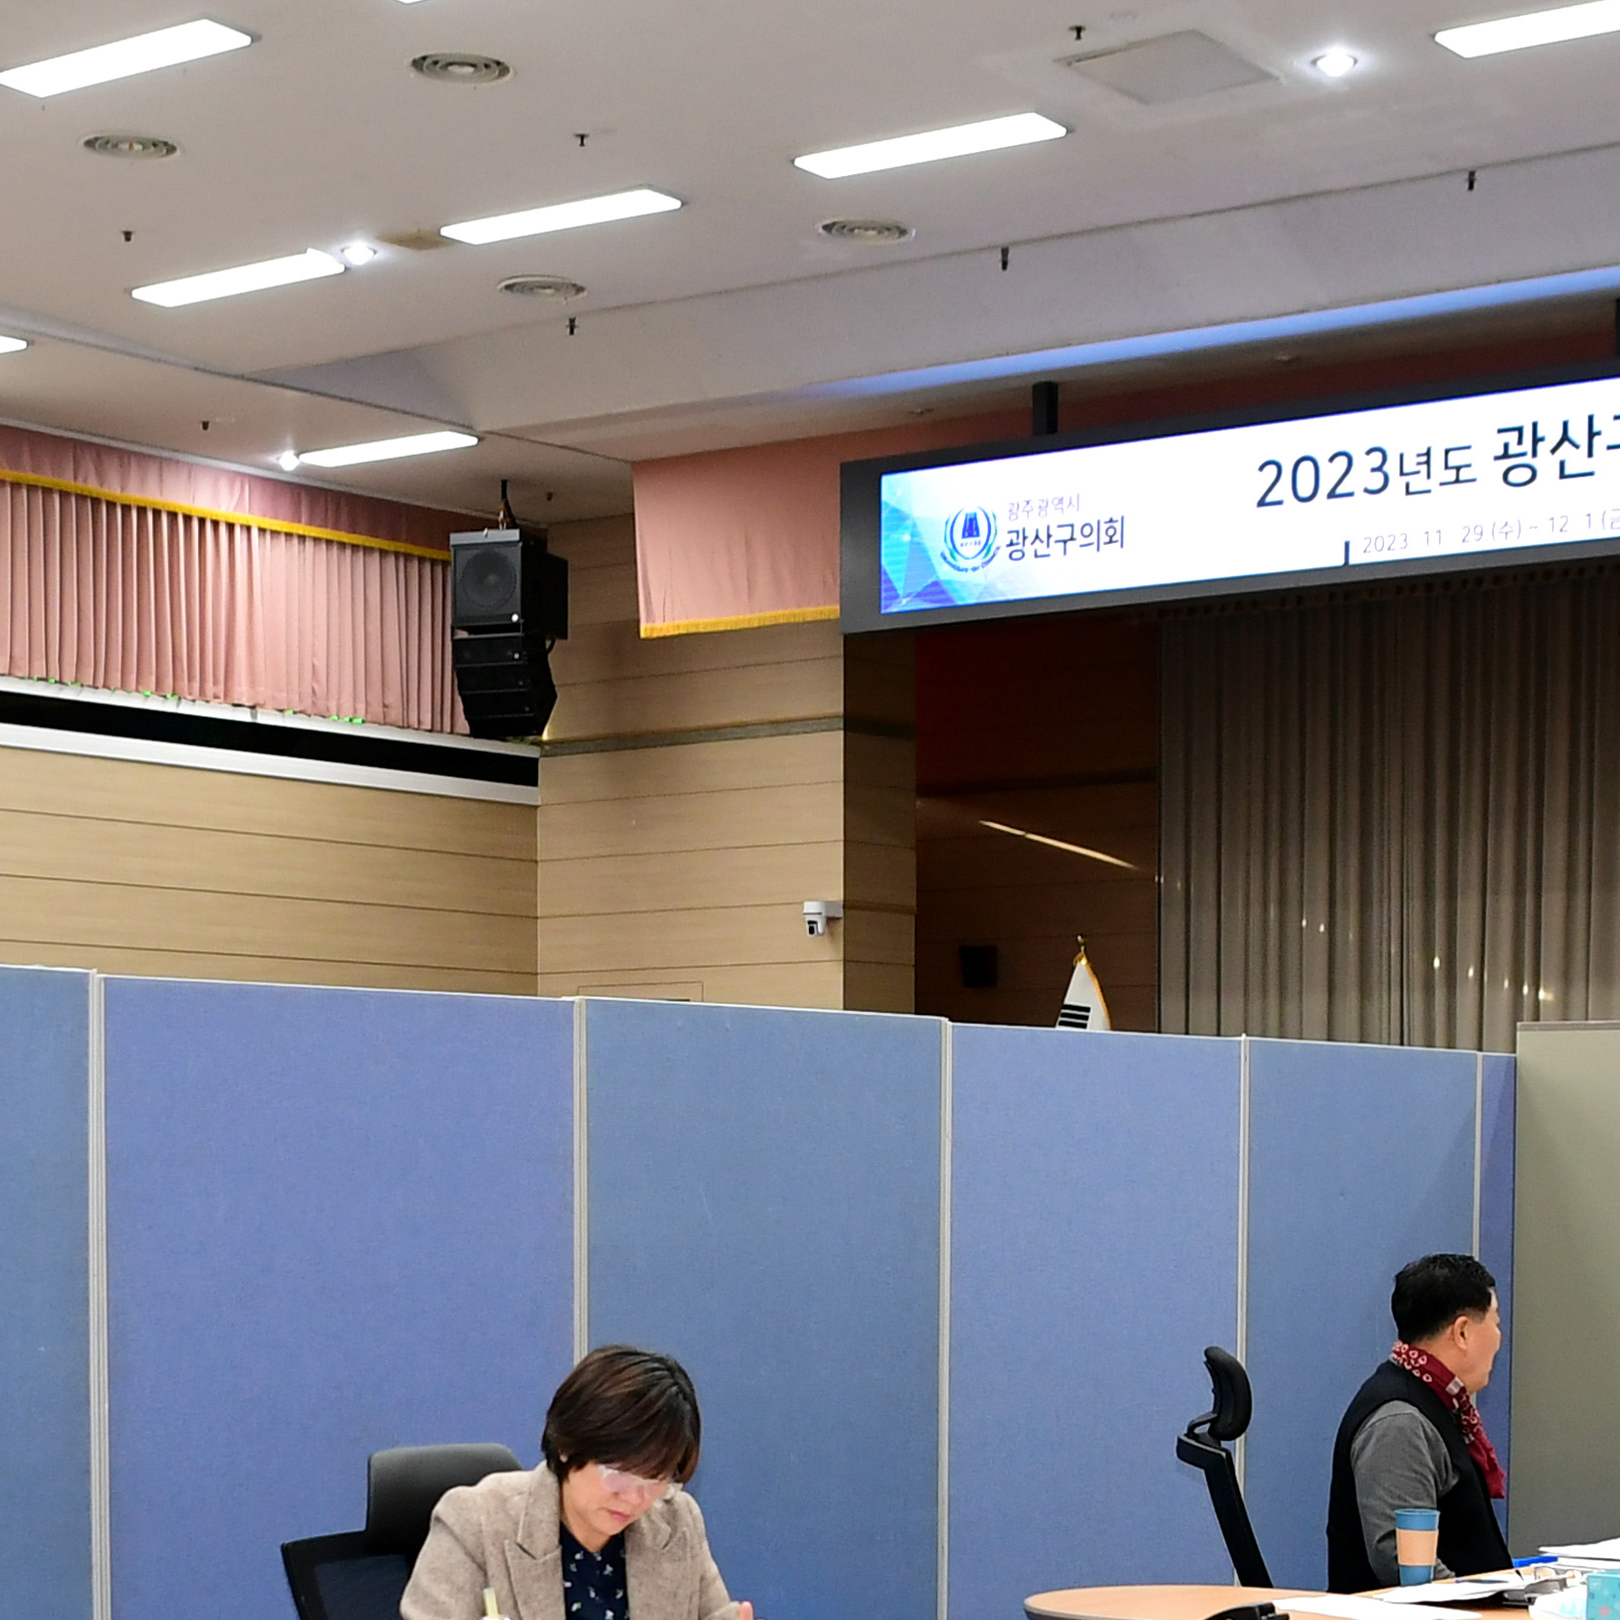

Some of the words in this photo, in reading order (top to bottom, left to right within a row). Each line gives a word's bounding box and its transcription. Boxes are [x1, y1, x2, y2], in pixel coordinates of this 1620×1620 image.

[1256, 445, 1478, 508] 2023년도
[1007, 493, 1080, 521] 광주광역시
[1005, 515, 1125, 562] 광산구의회
